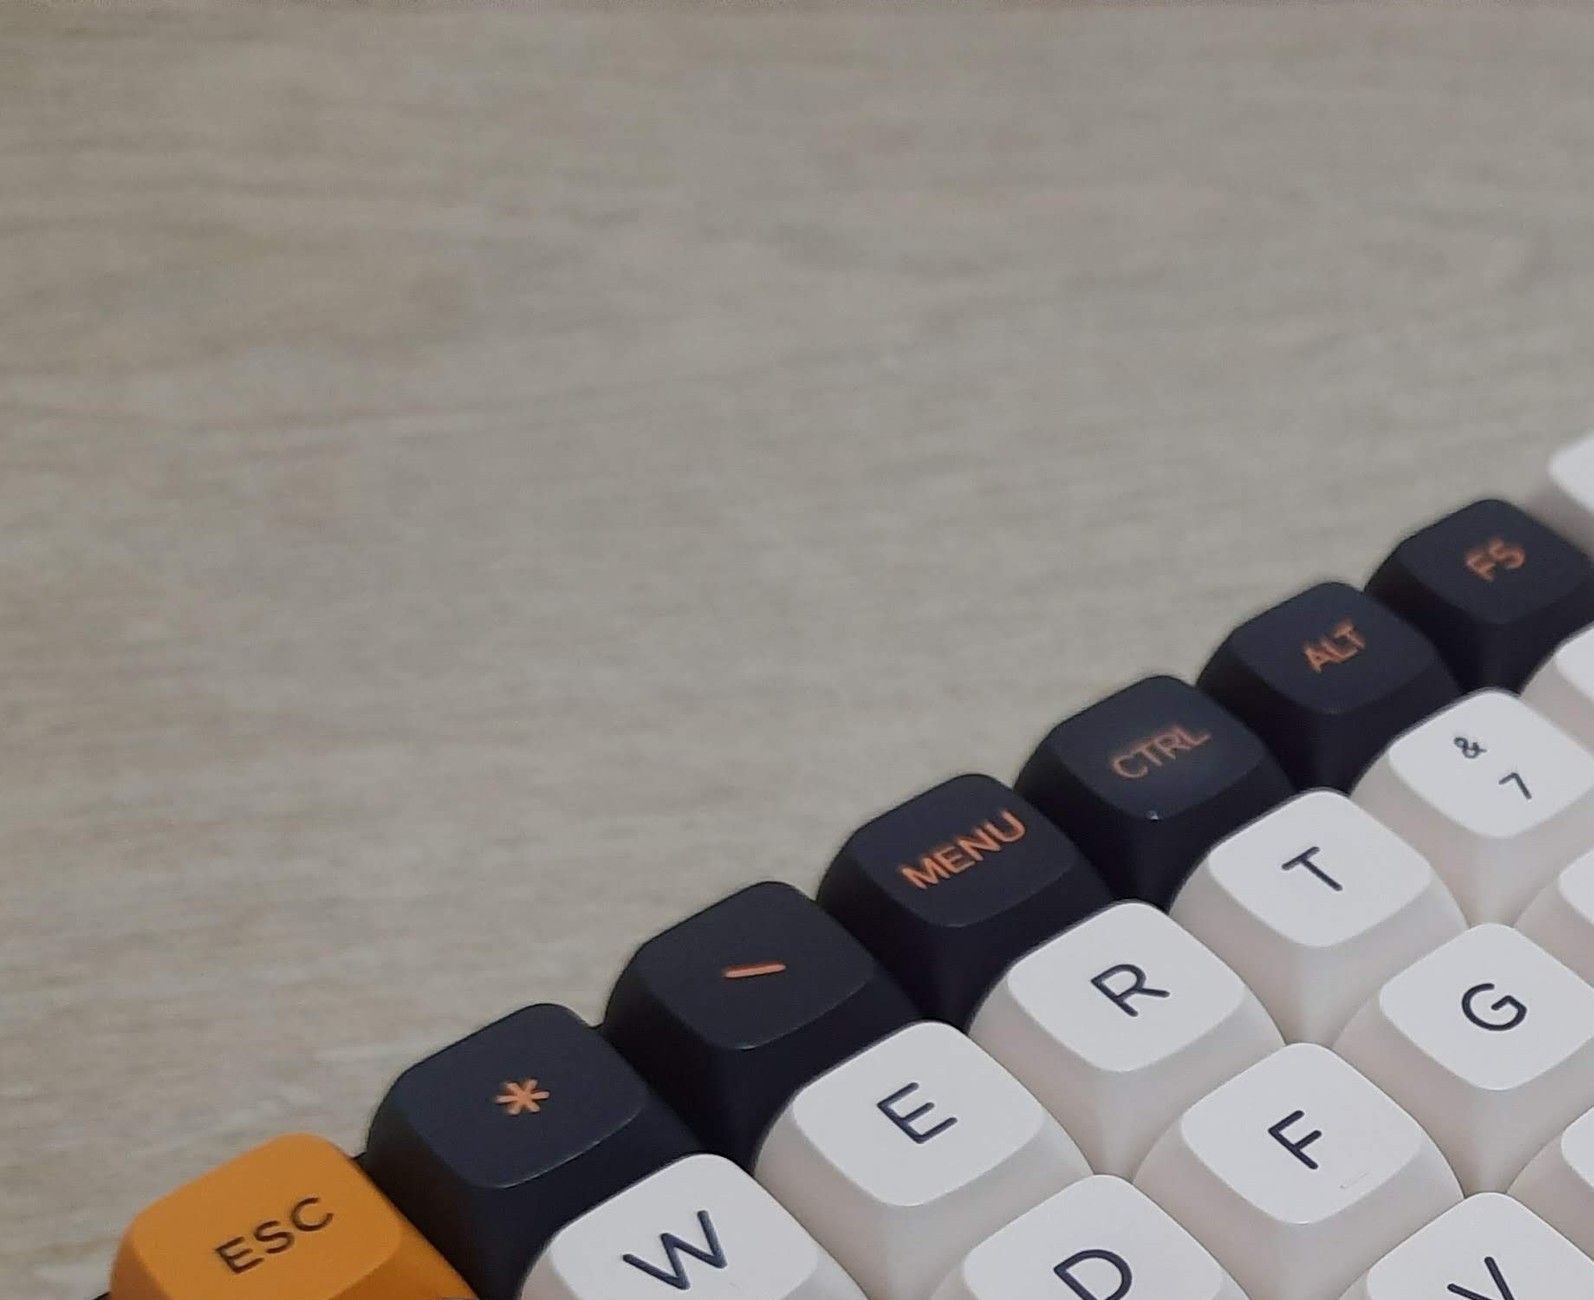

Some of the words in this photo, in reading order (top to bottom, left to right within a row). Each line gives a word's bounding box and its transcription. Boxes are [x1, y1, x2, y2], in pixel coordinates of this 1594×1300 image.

[1303, 621, 1365, 673] ALT
[1110, 724, 1211, 779] CTRL
[1453, 736, 1487, 759] &
[1498, 771, 1532, 800] 7
[899, 810, 1028, 891] MENU
[1281, 845, 1343, 892] T
[1089, 963, 1170, 1018] R
[1460, 982, 1528, 1032] G
[876, 1081, 958, 1145] E
[1267, 1109, 1323, 1171] F
[213, 1196, 334, 1275] ESC
[621, 1210, 727, 1291] W
